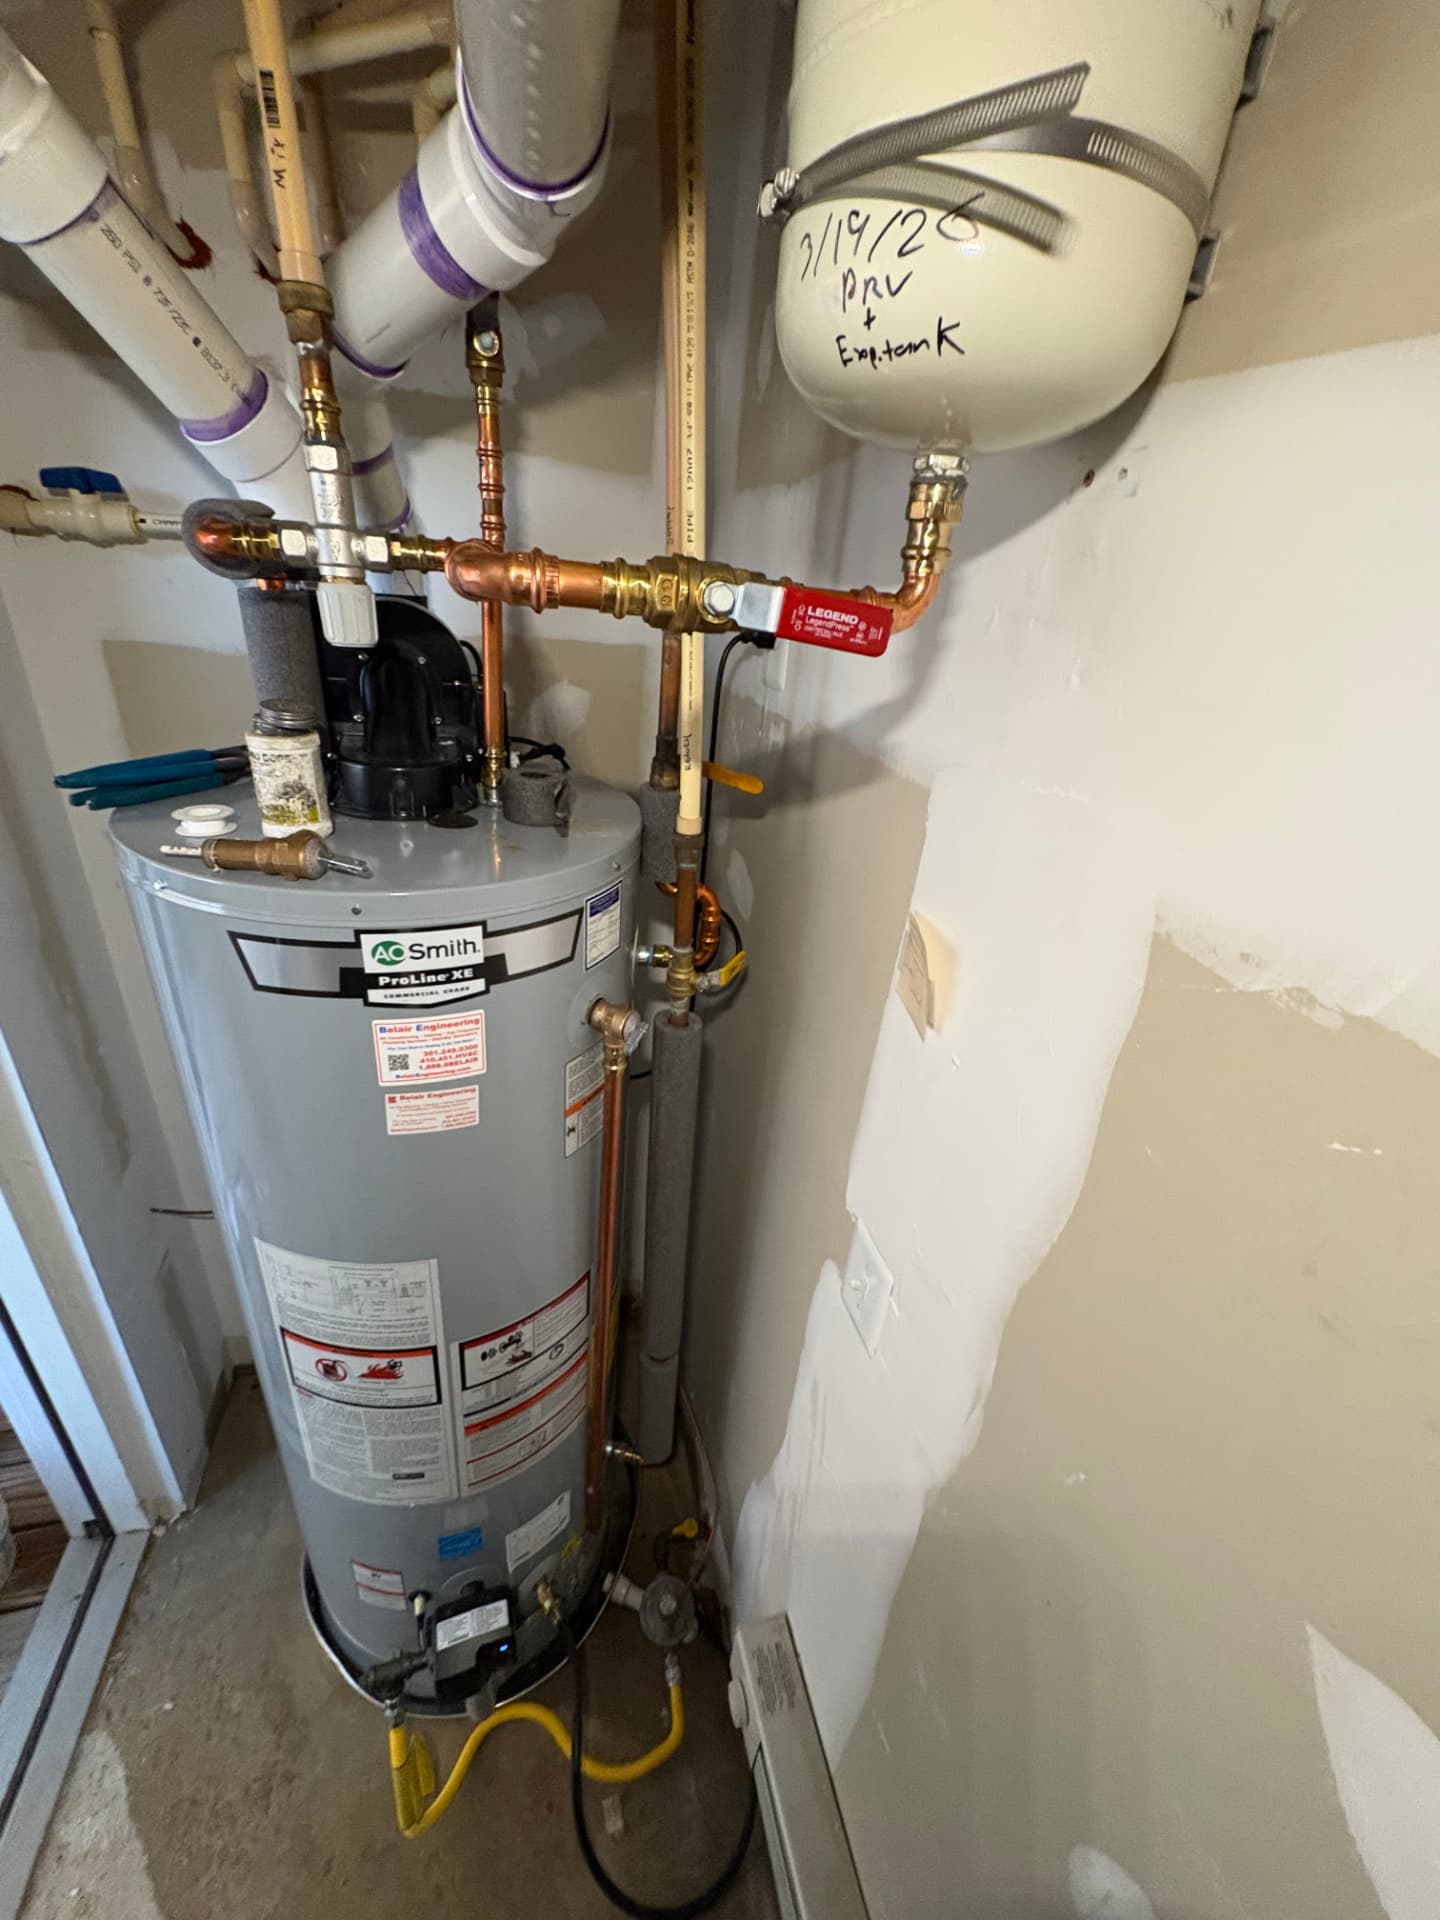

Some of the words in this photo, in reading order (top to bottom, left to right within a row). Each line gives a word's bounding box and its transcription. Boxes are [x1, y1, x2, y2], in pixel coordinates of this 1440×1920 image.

[842, 266, 913, 314] PRV
[686, 511, 695, 544] PIPE
[806, 605, 859, 626] LEGEND
[408, 938, 477, 961] Smith
[450, 967, 474, 980] XE
[378, 1025, 412, 1034] Belair
[415, 1018, 480, 1032] Engineering
